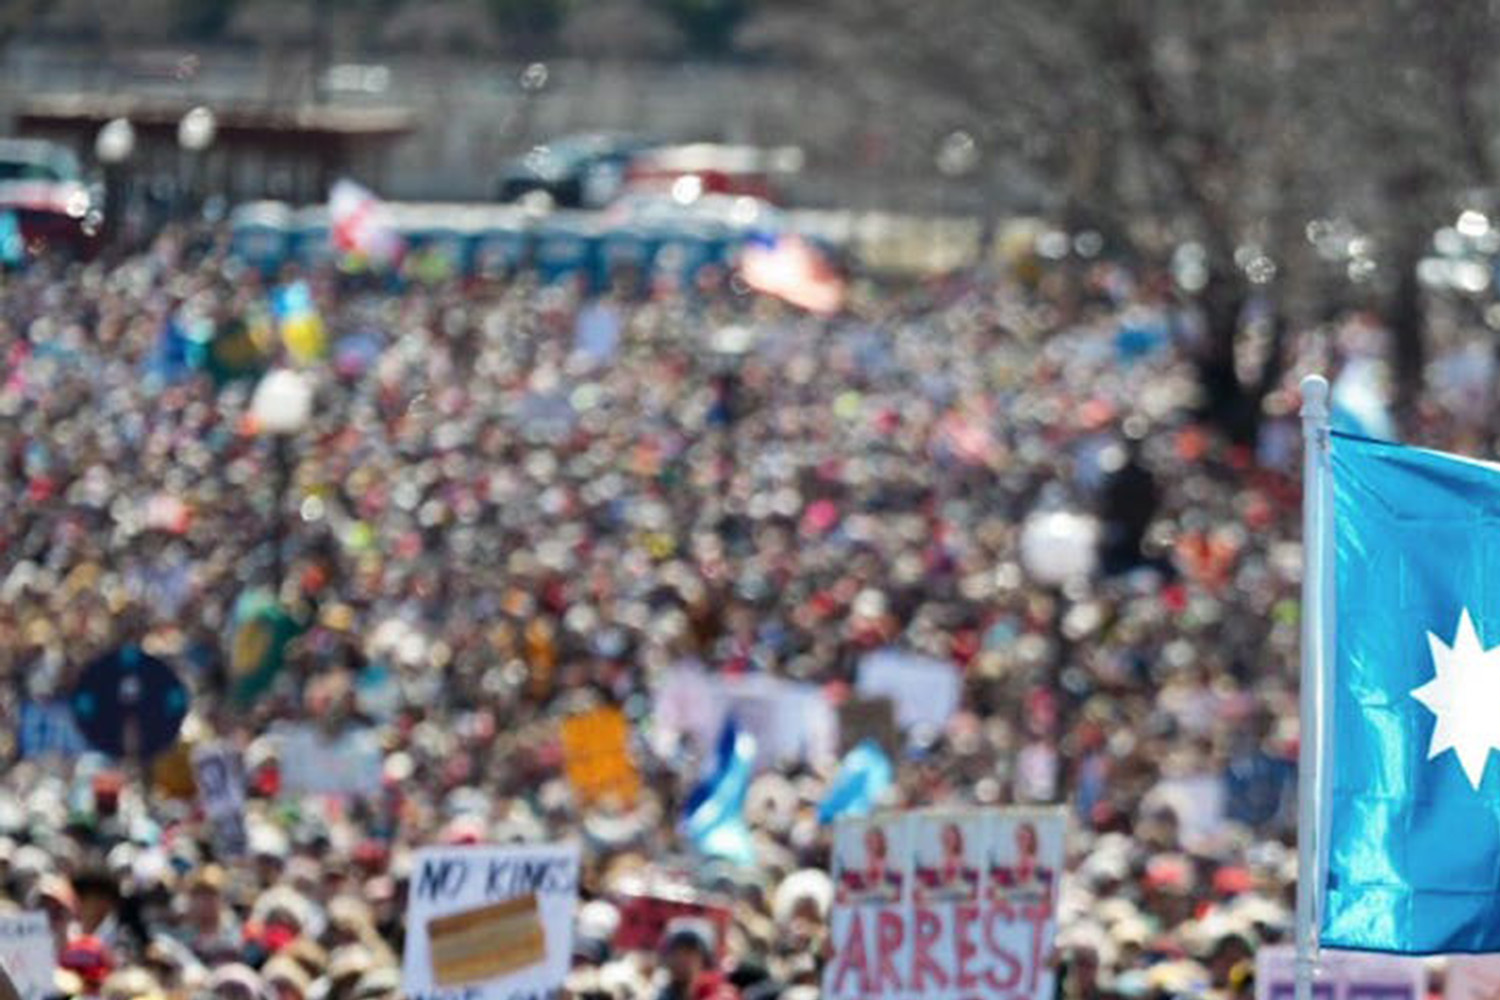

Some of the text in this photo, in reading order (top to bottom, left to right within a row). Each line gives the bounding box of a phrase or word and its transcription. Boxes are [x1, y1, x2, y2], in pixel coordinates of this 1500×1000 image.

[418, 859, 576, 899] NO KINGS
[833, 899, 1053, 994] ARREST
